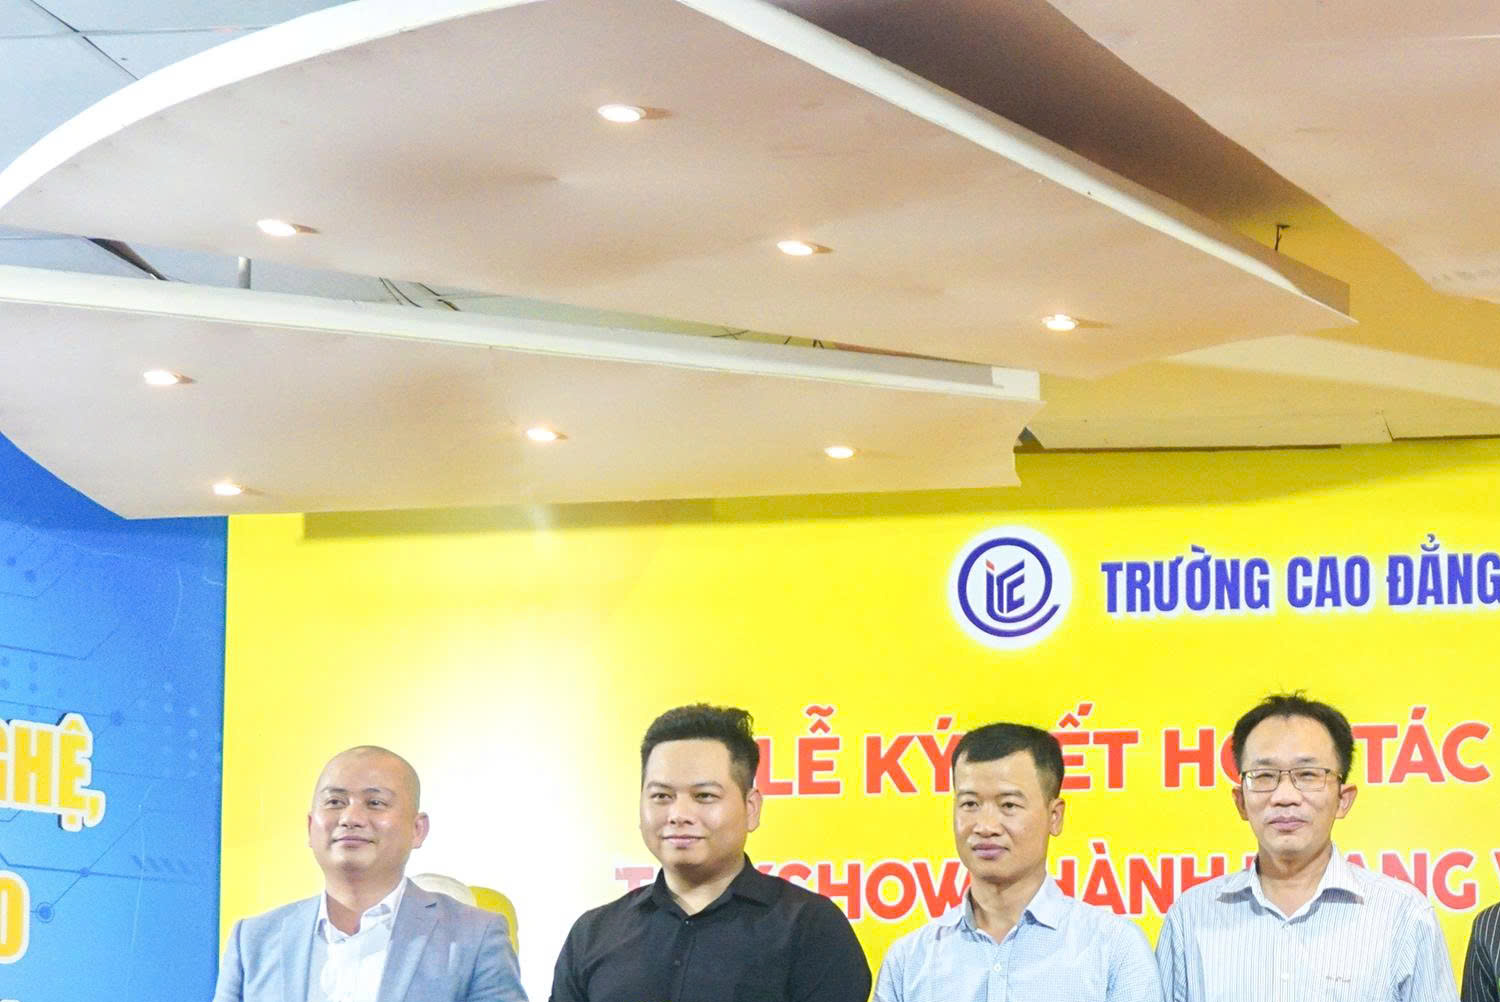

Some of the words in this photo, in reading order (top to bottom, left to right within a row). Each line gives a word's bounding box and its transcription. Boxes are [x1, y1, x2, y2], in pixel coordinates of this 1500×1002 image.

[1101, 547, 1270, 613] TRƯỜNG
[1288, 556, 1370, 608] CAO
[755, 705, 841, 796] LỄ
[866, 716, 966, 794] KÝ
[1050, 703, 1139, 790] ẾT
[1351, 706, 1491, 784] TÁC
